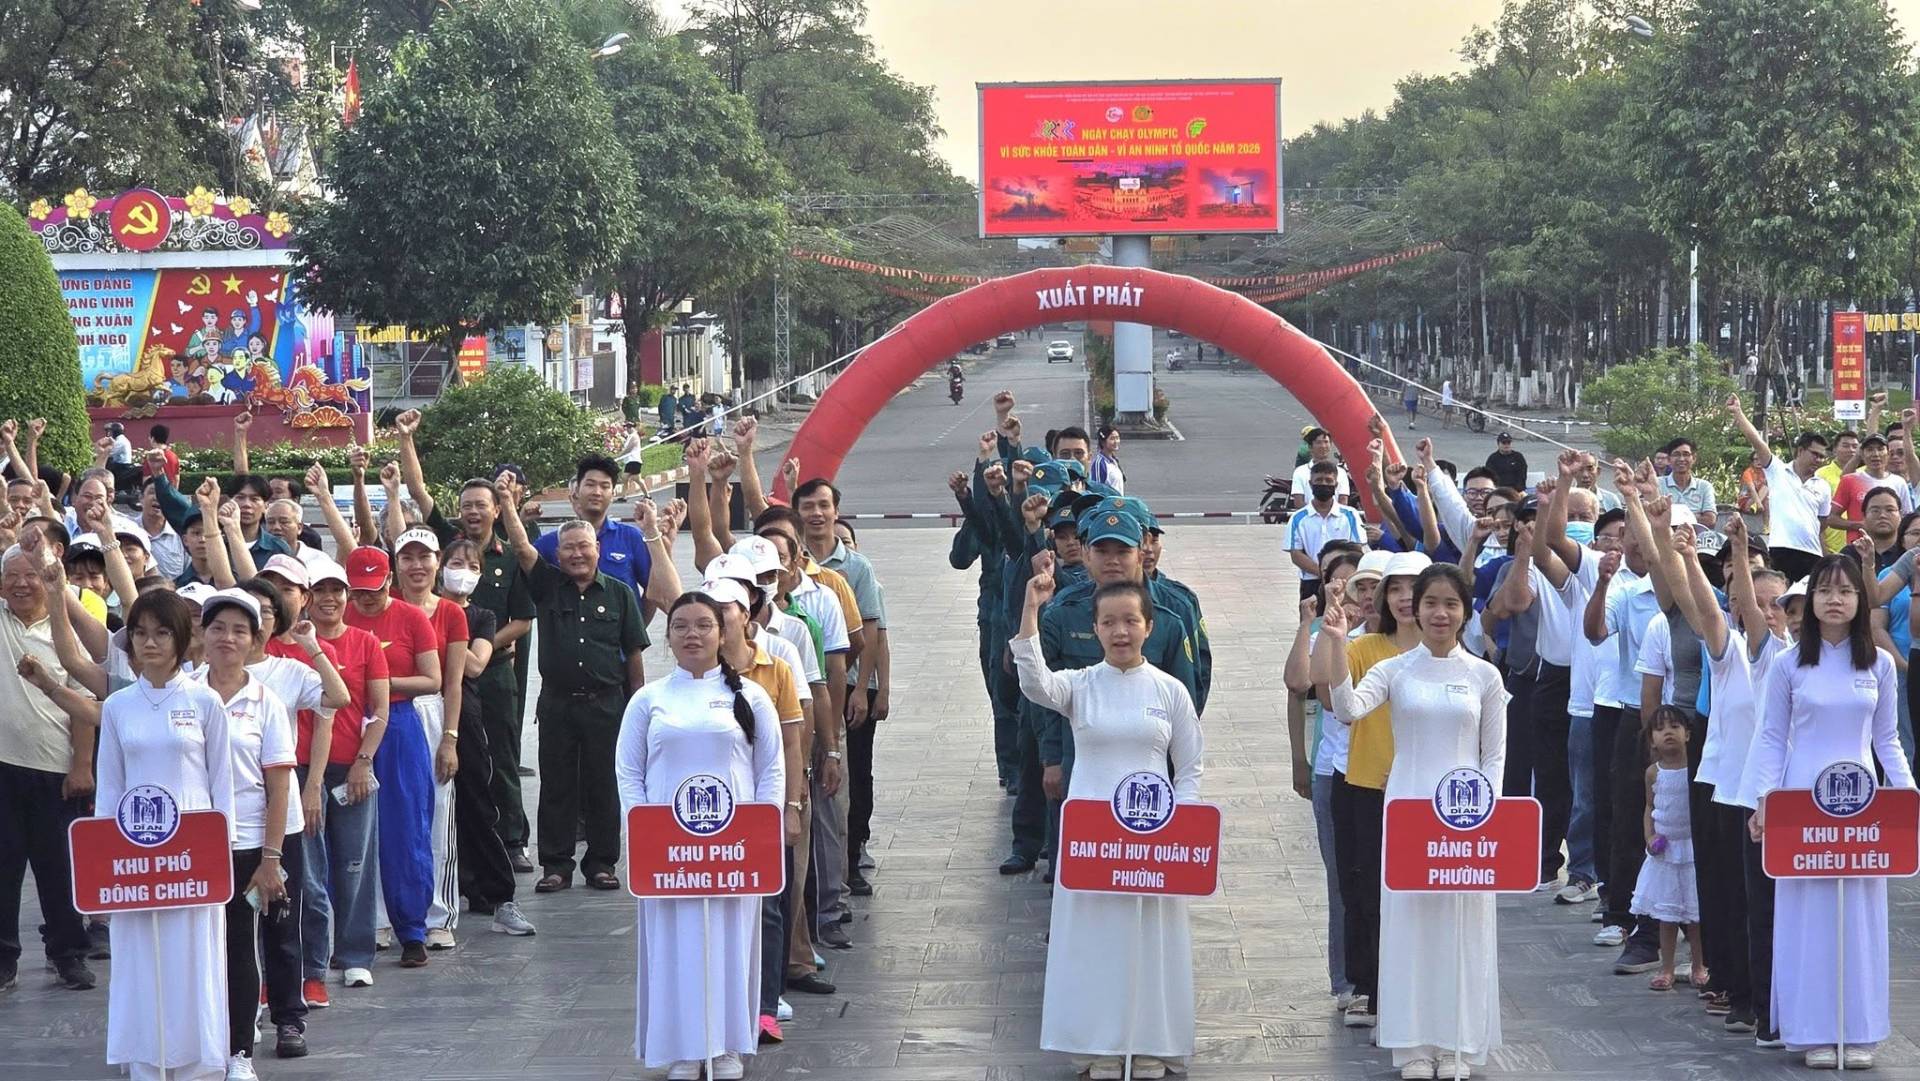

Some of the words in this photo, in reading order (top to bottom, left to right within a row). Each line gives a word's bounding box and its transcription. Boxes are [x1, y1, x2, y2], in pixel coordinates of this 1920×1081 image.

[1082, 127, 1107, 141] NGÀY
[1110, 128, 1135, 142] CHẠY
[1137, 127, 1178, 140] OLYMPIC
[1000, 145, 1010, 158] VÌ
[1012, 144, 1031, 158] SỨC
[1061, 143, 1086, 158] TOÀN
[1088, 143, 1108, 157] DÂN
[1117, 143, 1126, 157] VÌ
[1128, 144, 1142, 156] AN
[1144, 144, 1168, 156] NINH
[1184, 140, 1210, 156] QUỐC
[1212, 141, 1235, 155] NĂM
[1237, 143, 1260, 155] 2026
[65, 297, 97, 309] ANG
[101, 297, 134, 309] VINH
[1036, 279, 1086, 311] XUẤT
[1093, 281, 1144, 308] PHÁT
[70, 316, 91, 328] NG
[95, 313, 133, 327] XUÂN
[1865, 313, 1898, 336] VẠN
[98, 333, 127, 348] NGỌ
[1802, 826, 1839, 843] KHU
[1844, 820, 1881, 843] PHỐ
[668, 845, 704, 862] KHU
[709, 838, 745, 862] PHỐ
[1070, 841, 1097, 858] BAN
[1100, 838, 1123, 859] CHỈ
[1125, 843, 1151, 861] HUY
[1154, 842, 1189, 863] QUÂN
[1192, 845, 1212, 867] SỰ
[1427, 835, 1472, 858] ĐẢNG
[1477, 835, 1498, 858] ỦY
[113, 857, 150, 876] KHU
[155, 848, 192, 873] PHỐ
[1793, 850, 1846, 870] CHIÊU
[1851, 849, 1890, 869] LIÊU
[653, 867, 712, 889] THẮNG
[717, 869, 745, 891] LỢI
[751, 872, 760, 888] 1
[1112, 867, 1165, 889] PHƯỜNG
[1428, 864, 1496, 886] PHƯỜNG
[99, 883, 150, 905] ĐÔNG
[155, 878, 208, 901] CHIÊU
